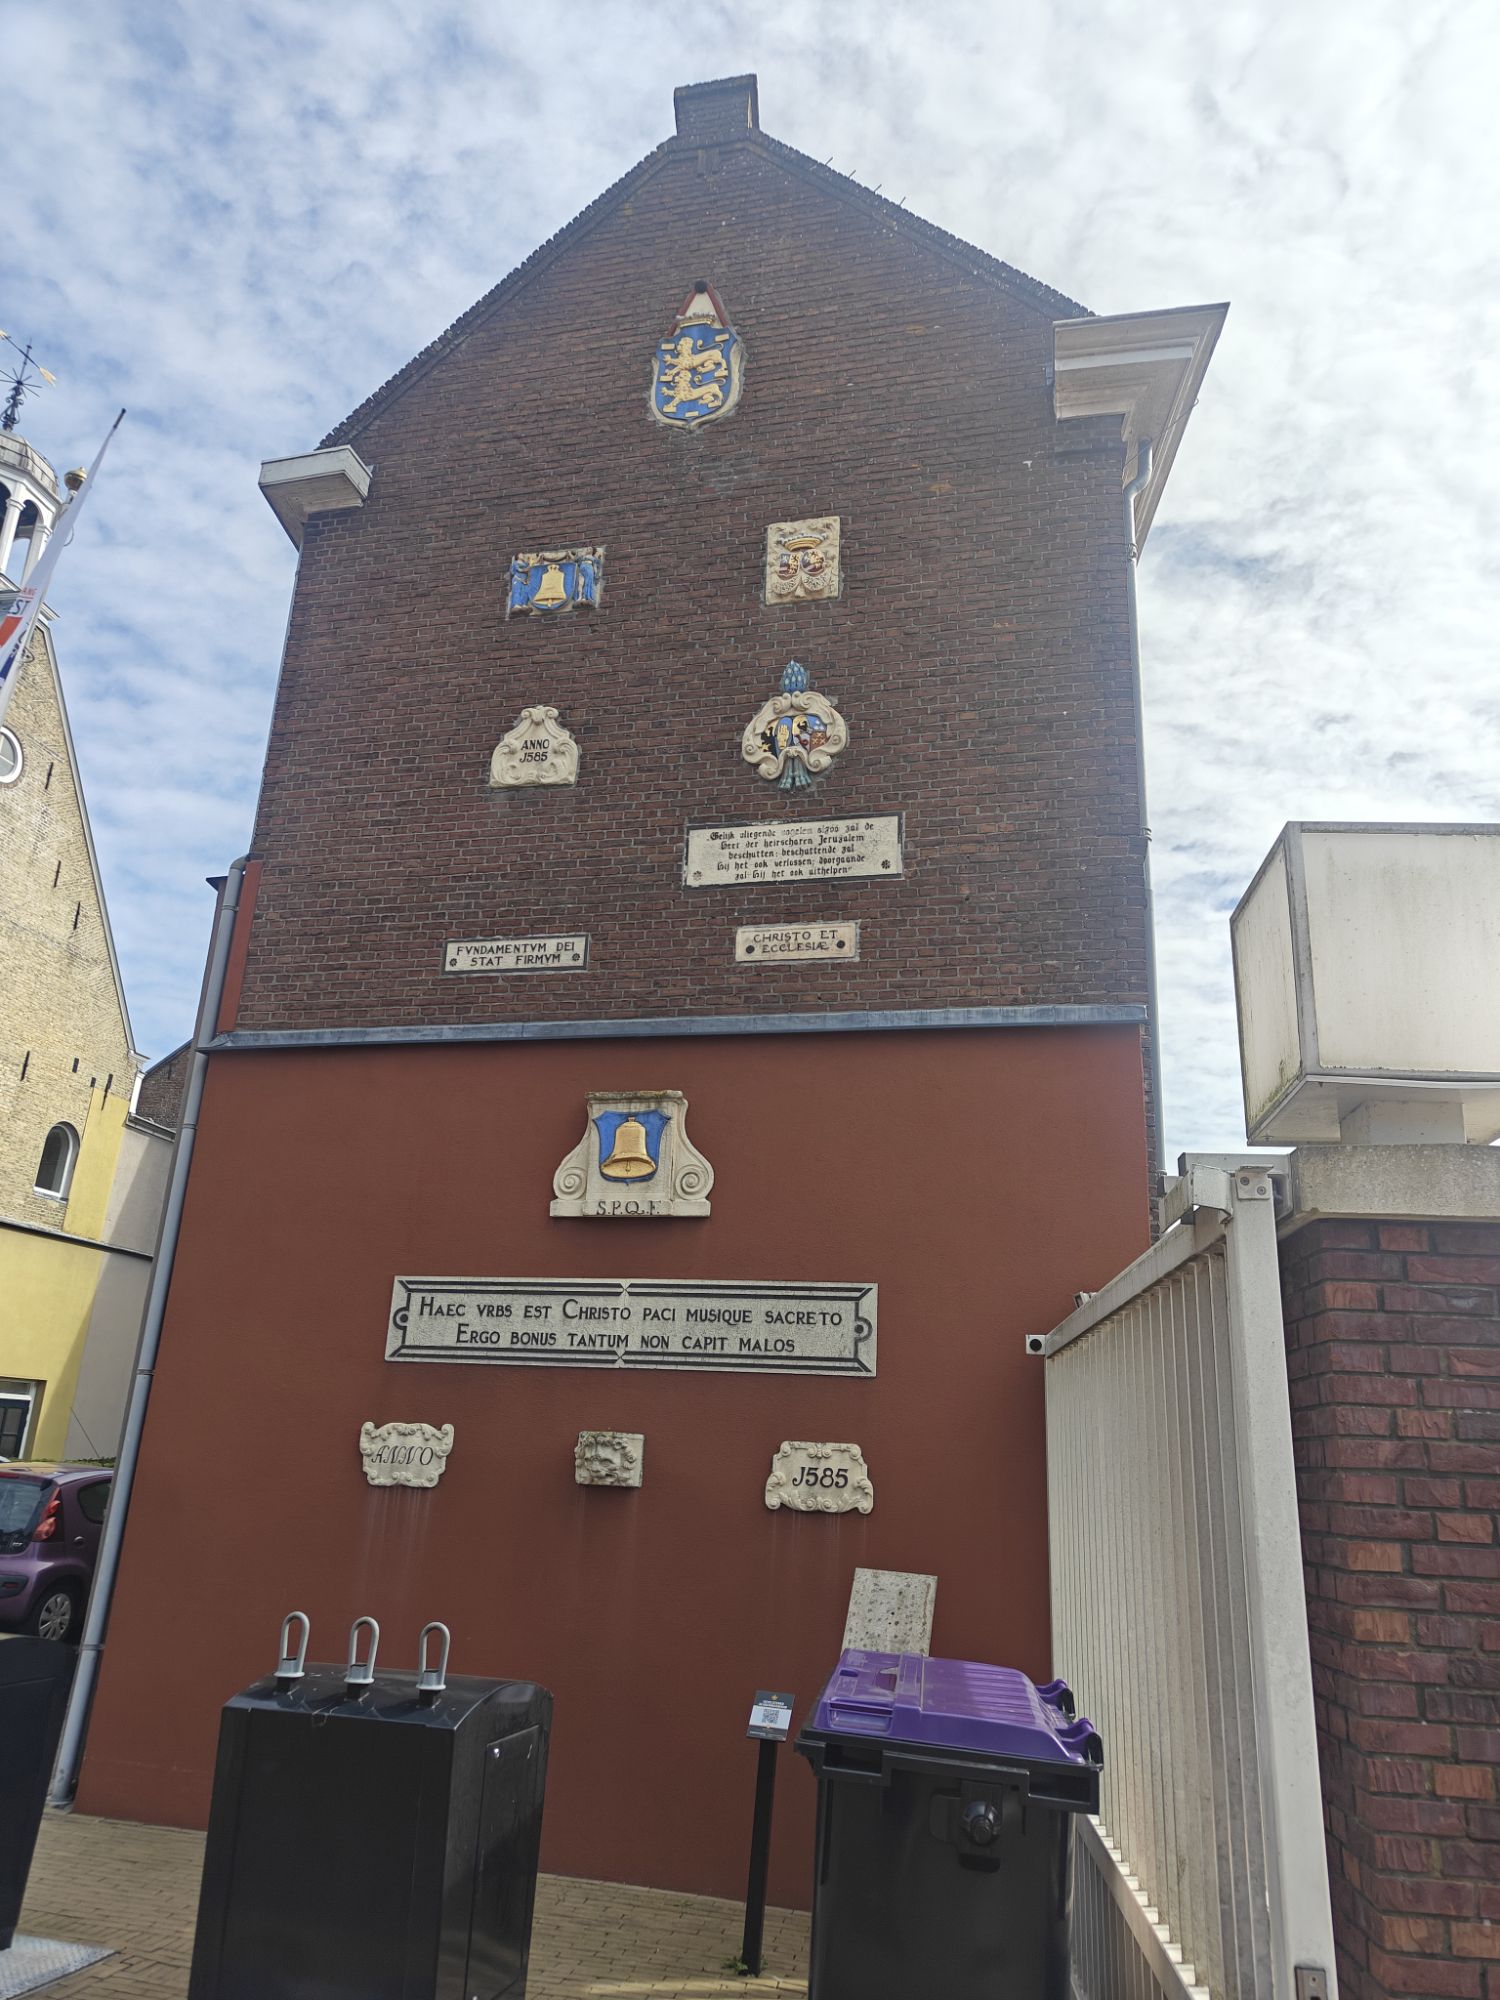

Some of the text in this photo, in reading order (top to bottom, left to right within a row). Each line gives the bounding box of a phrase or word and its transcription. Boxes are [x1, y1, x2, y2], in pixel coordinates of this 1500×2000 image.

[521, 739, 550, 751] ANNO
[845, 823, 859, 833] zal
[864, 822, 875, 831] de
[720, 834, 865, 851] Heer der heirscharen Jeruzalem
[781, 845, 836, 858] beschuttende
[841, 844, 855, 855] zal
[717, 861, 730, 873] Hij
[734, 860, 749, 871] het
[754, 859, 769, 868] ook
[818, 854, 866, 866] doorgaande
[771, 868, 785, 878] het
[789, 868, 804, 877] ook
[753, 929, 839, 943] CHRISTO ET
[456, 942, 576, 956] FVNDAMENTVM DEI
[470, 953, 561, 967] STAT FIRMVM
[477, 1304, 513, 1318] VRBS
[523, 1305, 552, 1319] EST
[643, 1307, 676, 1322] PACI
[686, 1308, 752, 1325] MUSIQUE
[764, 1311, 842, 1326] SACRETO
[510, 1331, 556, 1346] BONUS
[567, 1333, 629, 1348] TANTUM
[640, 1335, 670, 1349] NON
[682, 1336, 728, 1350] CAPIT
[739, 1338, 796, 1352] MALOS
[371, 1445, 434, 1466] ANNO
